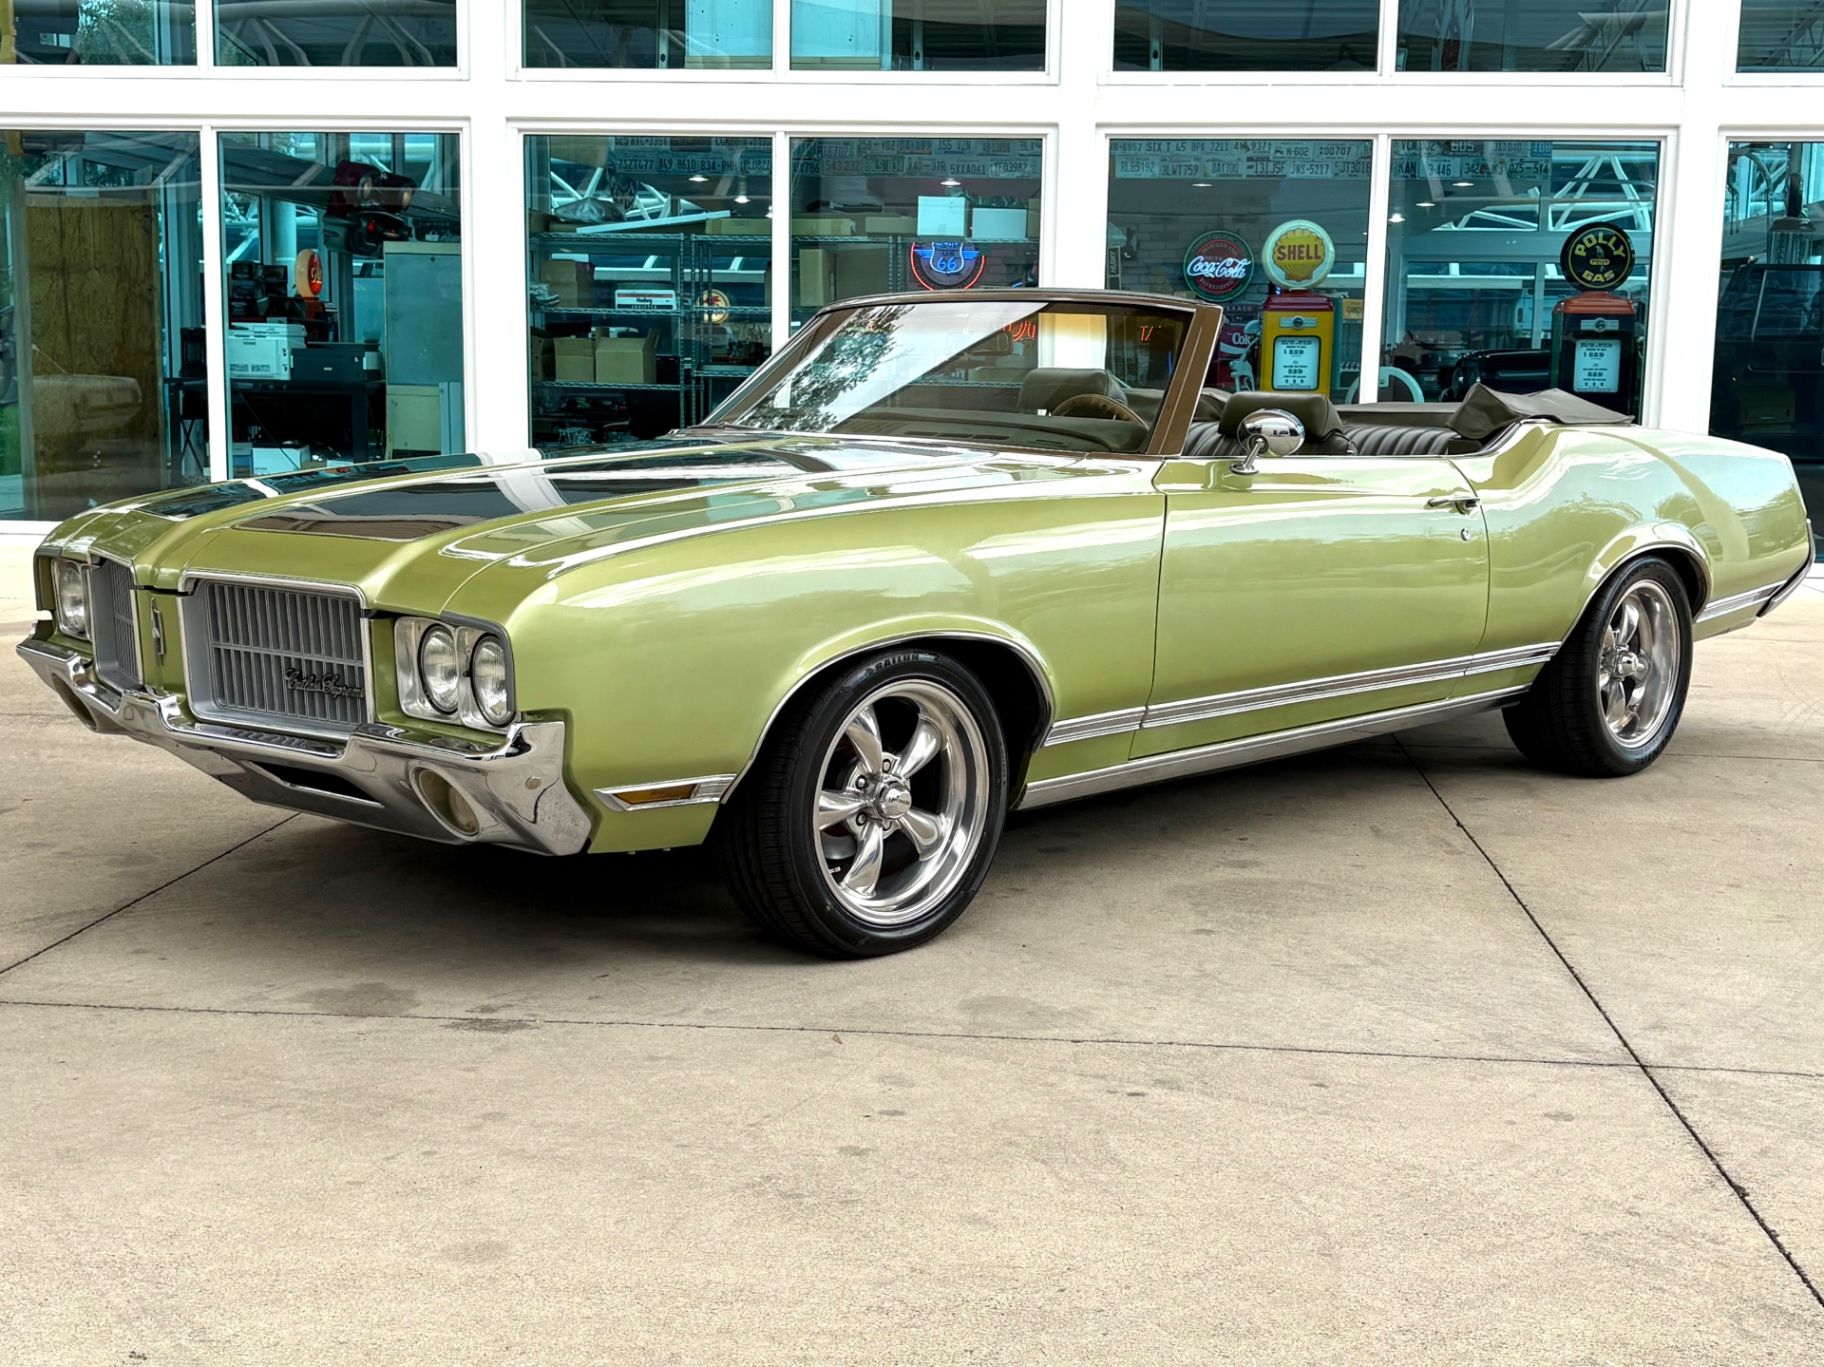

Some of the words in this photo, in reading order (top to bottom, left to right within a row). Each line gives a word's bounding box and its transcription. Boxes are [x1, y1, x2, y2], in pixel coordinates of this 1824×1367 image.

[1277, 244, 1322, 261] SHELL
[1574, 232, 1625, 258] POLLY
[937, 256, 957, 271] 66
[1582, 270, 1615, 283] GAS
[1232, 332, 1253, 345] Cok
